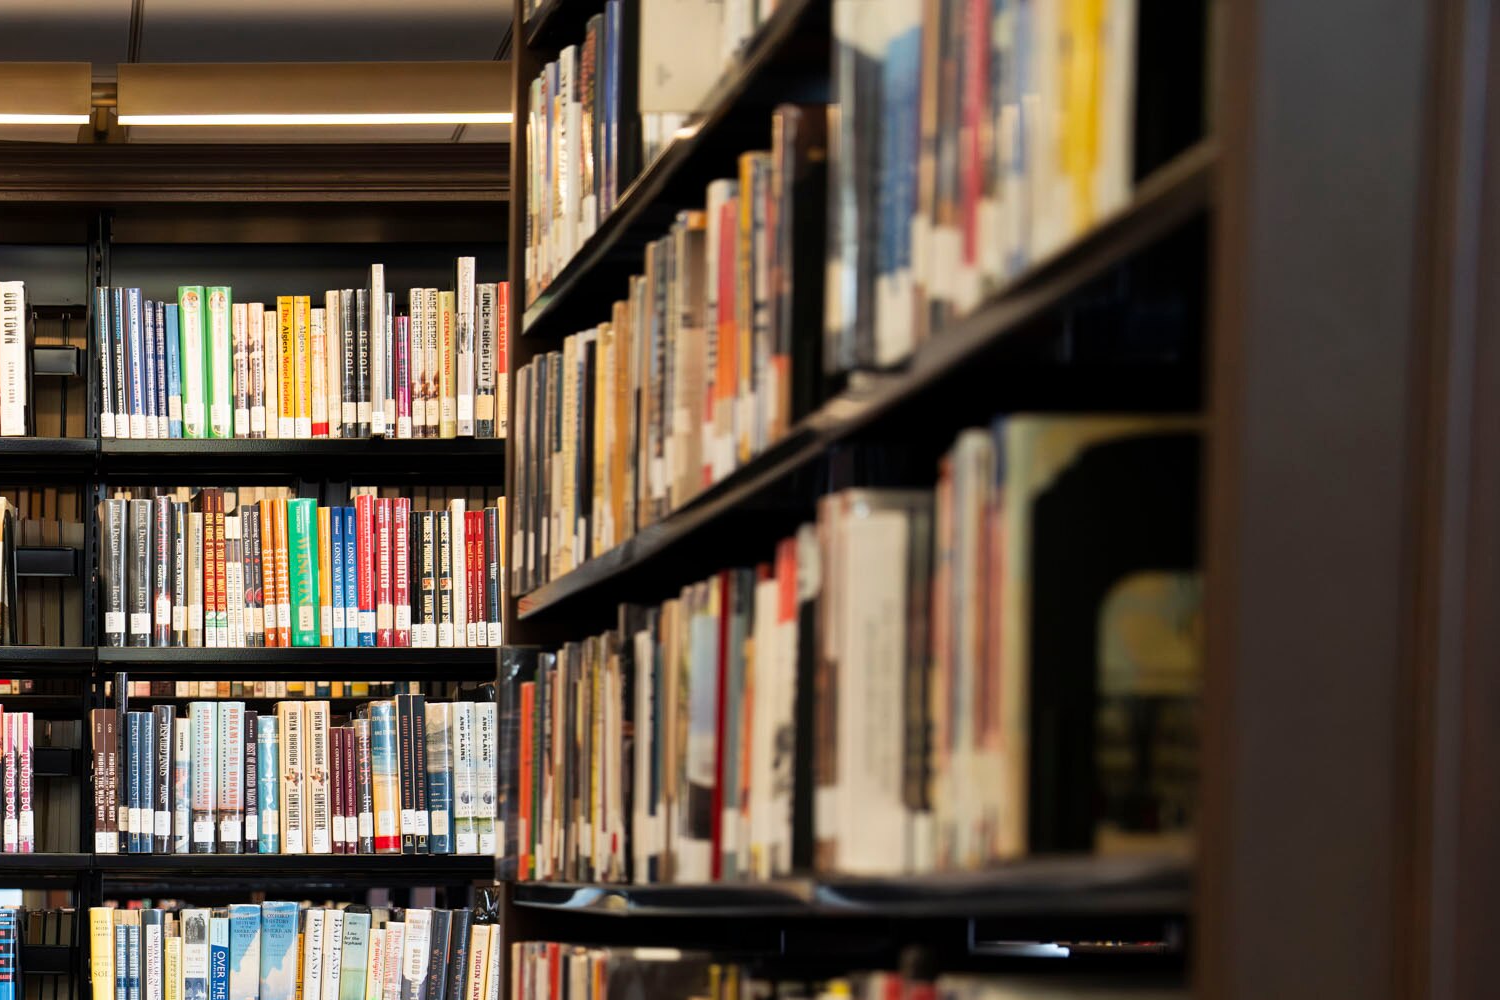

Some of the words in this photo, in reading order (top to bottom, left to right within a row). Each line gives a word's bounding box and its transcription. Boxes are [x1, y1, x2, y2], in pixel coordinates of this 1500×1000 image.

[428, 321, 437, 349] DETROIT
[345, 330, 353, 376] DETROIT
[138, 505, 146, 527] Black
[138, 529, 146, 557] Detroit
[314, 712, 324, 731] BRYAN
[315, 733, 325, 765] BURROUGH
[5, 751, 14, 793] TINDER
[97, 753, 105, 774] FINDING
[97, 776, 105, 788] THE
[217, 951, 225, 978] OVER
[474, 950, 482, 979] VIRGIN
[216, 981, 225, 999] THE
